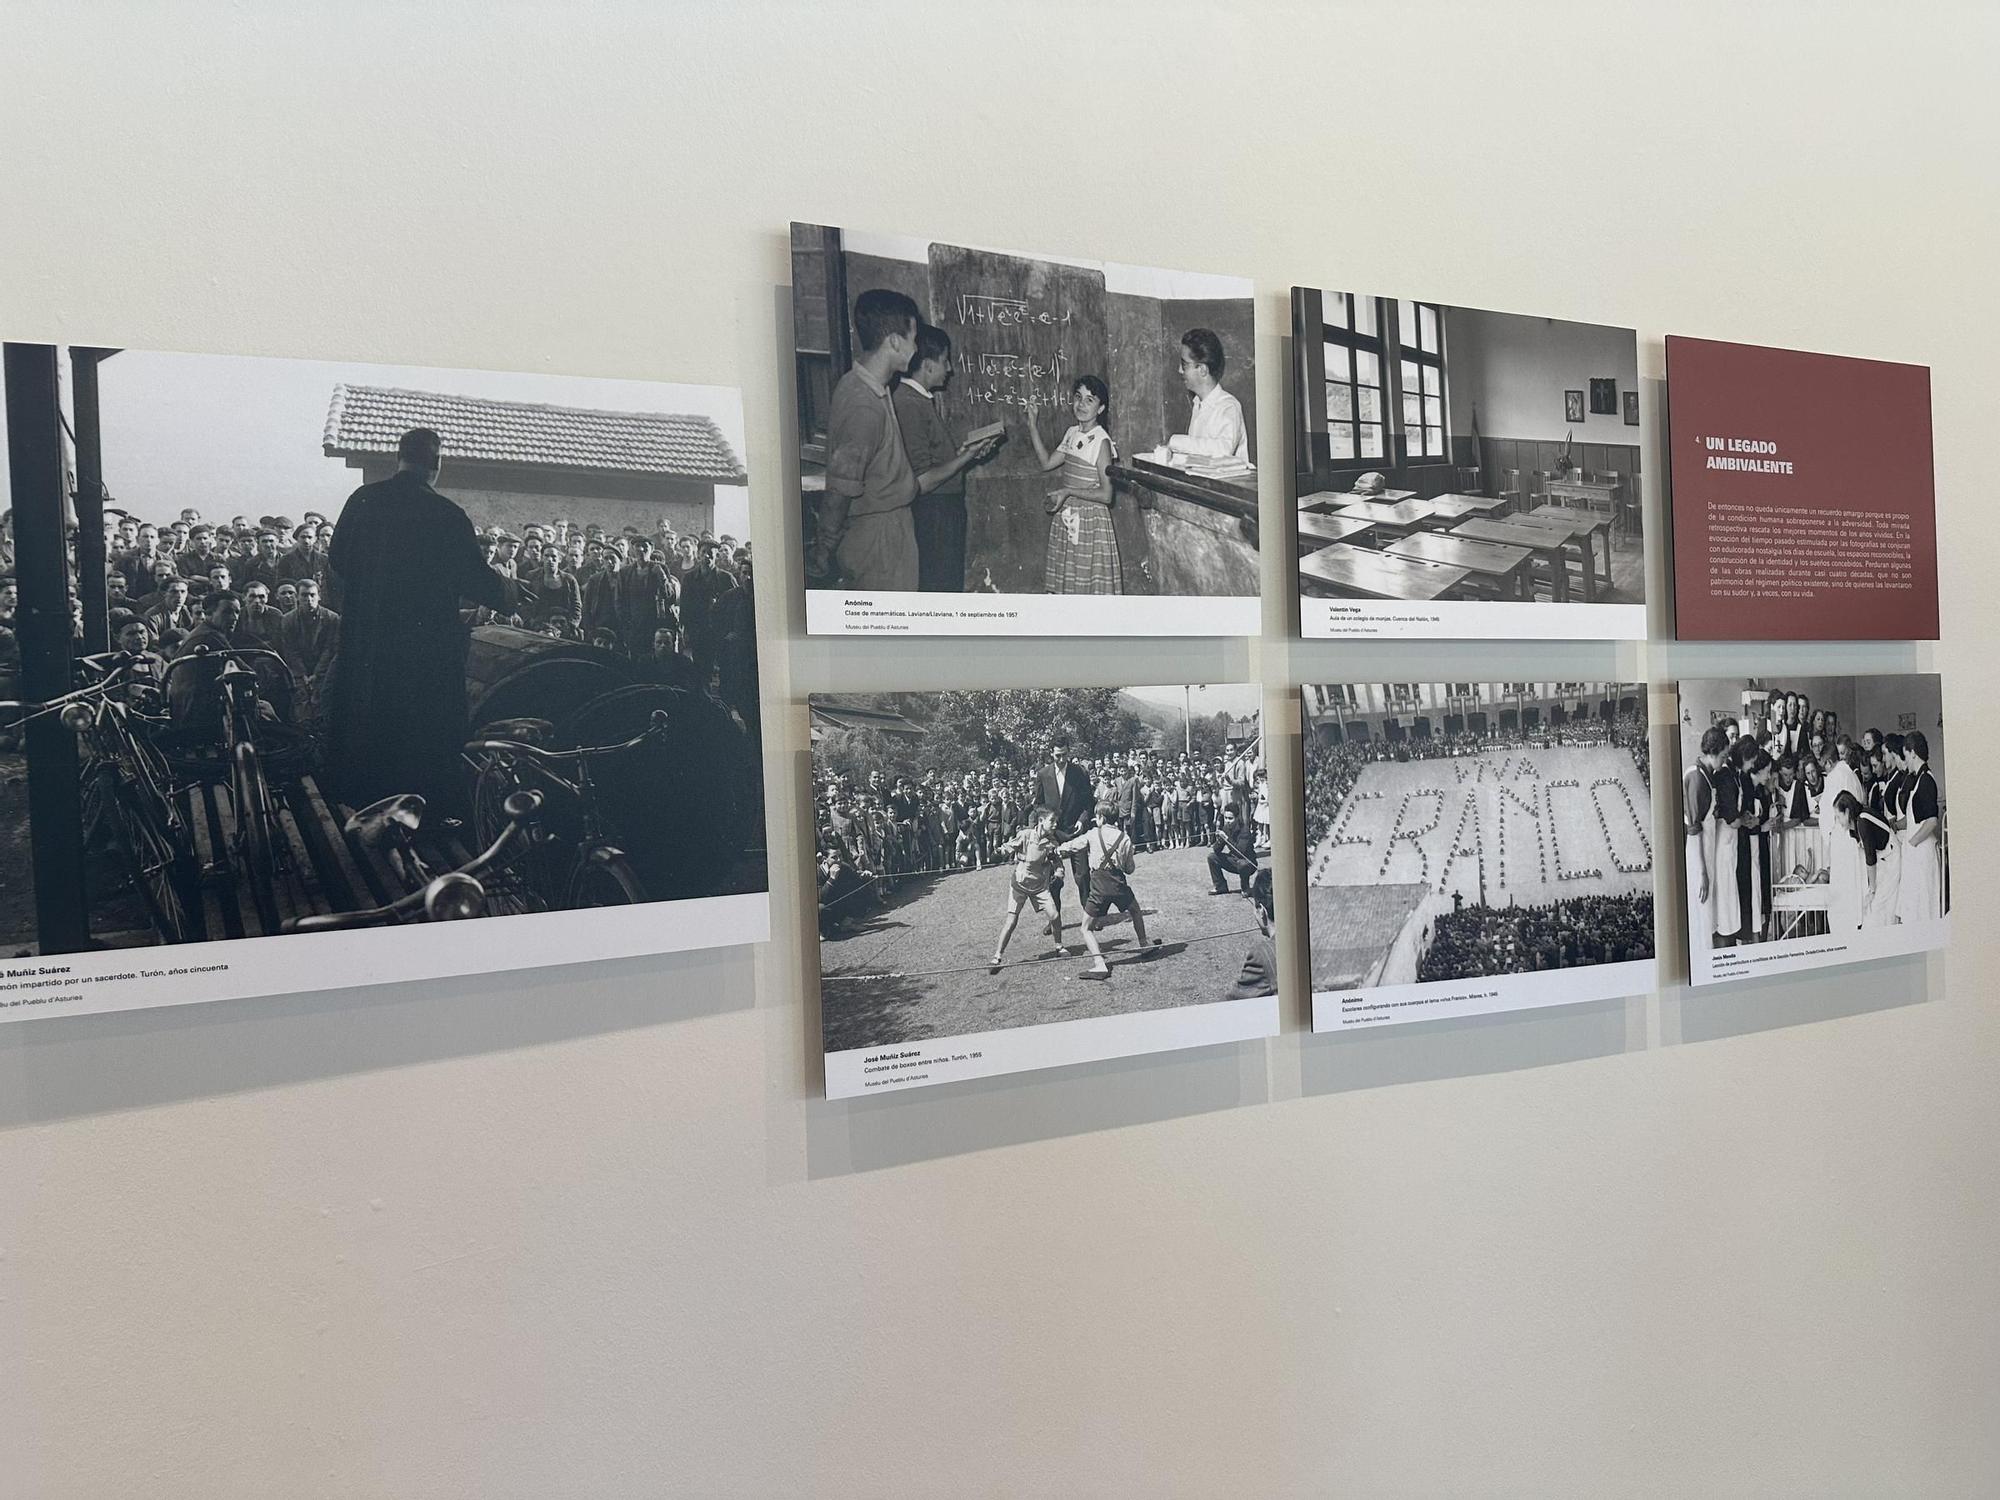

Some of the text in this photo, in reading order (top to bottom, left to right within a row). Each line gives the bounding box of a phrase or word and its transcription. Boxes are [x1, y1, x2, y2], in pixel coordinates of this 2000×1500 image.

[1706, 436, 1777, 455] UN LEGADO
[1706, 456, 1793, 475] AMBIVALENTE
[1311, 776, 1652, 894] FRANCO
[7, 969, 36, 978] Muñiz
[39, 966, 71, 975] Suárez
[20, 979, 62, 989] impartido
[64, 978, 79, 986] por
[95, 972, 137, 982] sacerdote.
[140, 970, 166, 978] Turón,
[168, 968, 188, 976] años
[190, 964, 229, 973] cincuenta
[10, 999, 20, 1007] del
[22, 997, 46, 1005] Pueblu
[880, 1053, 899, 1061] Muñiz
